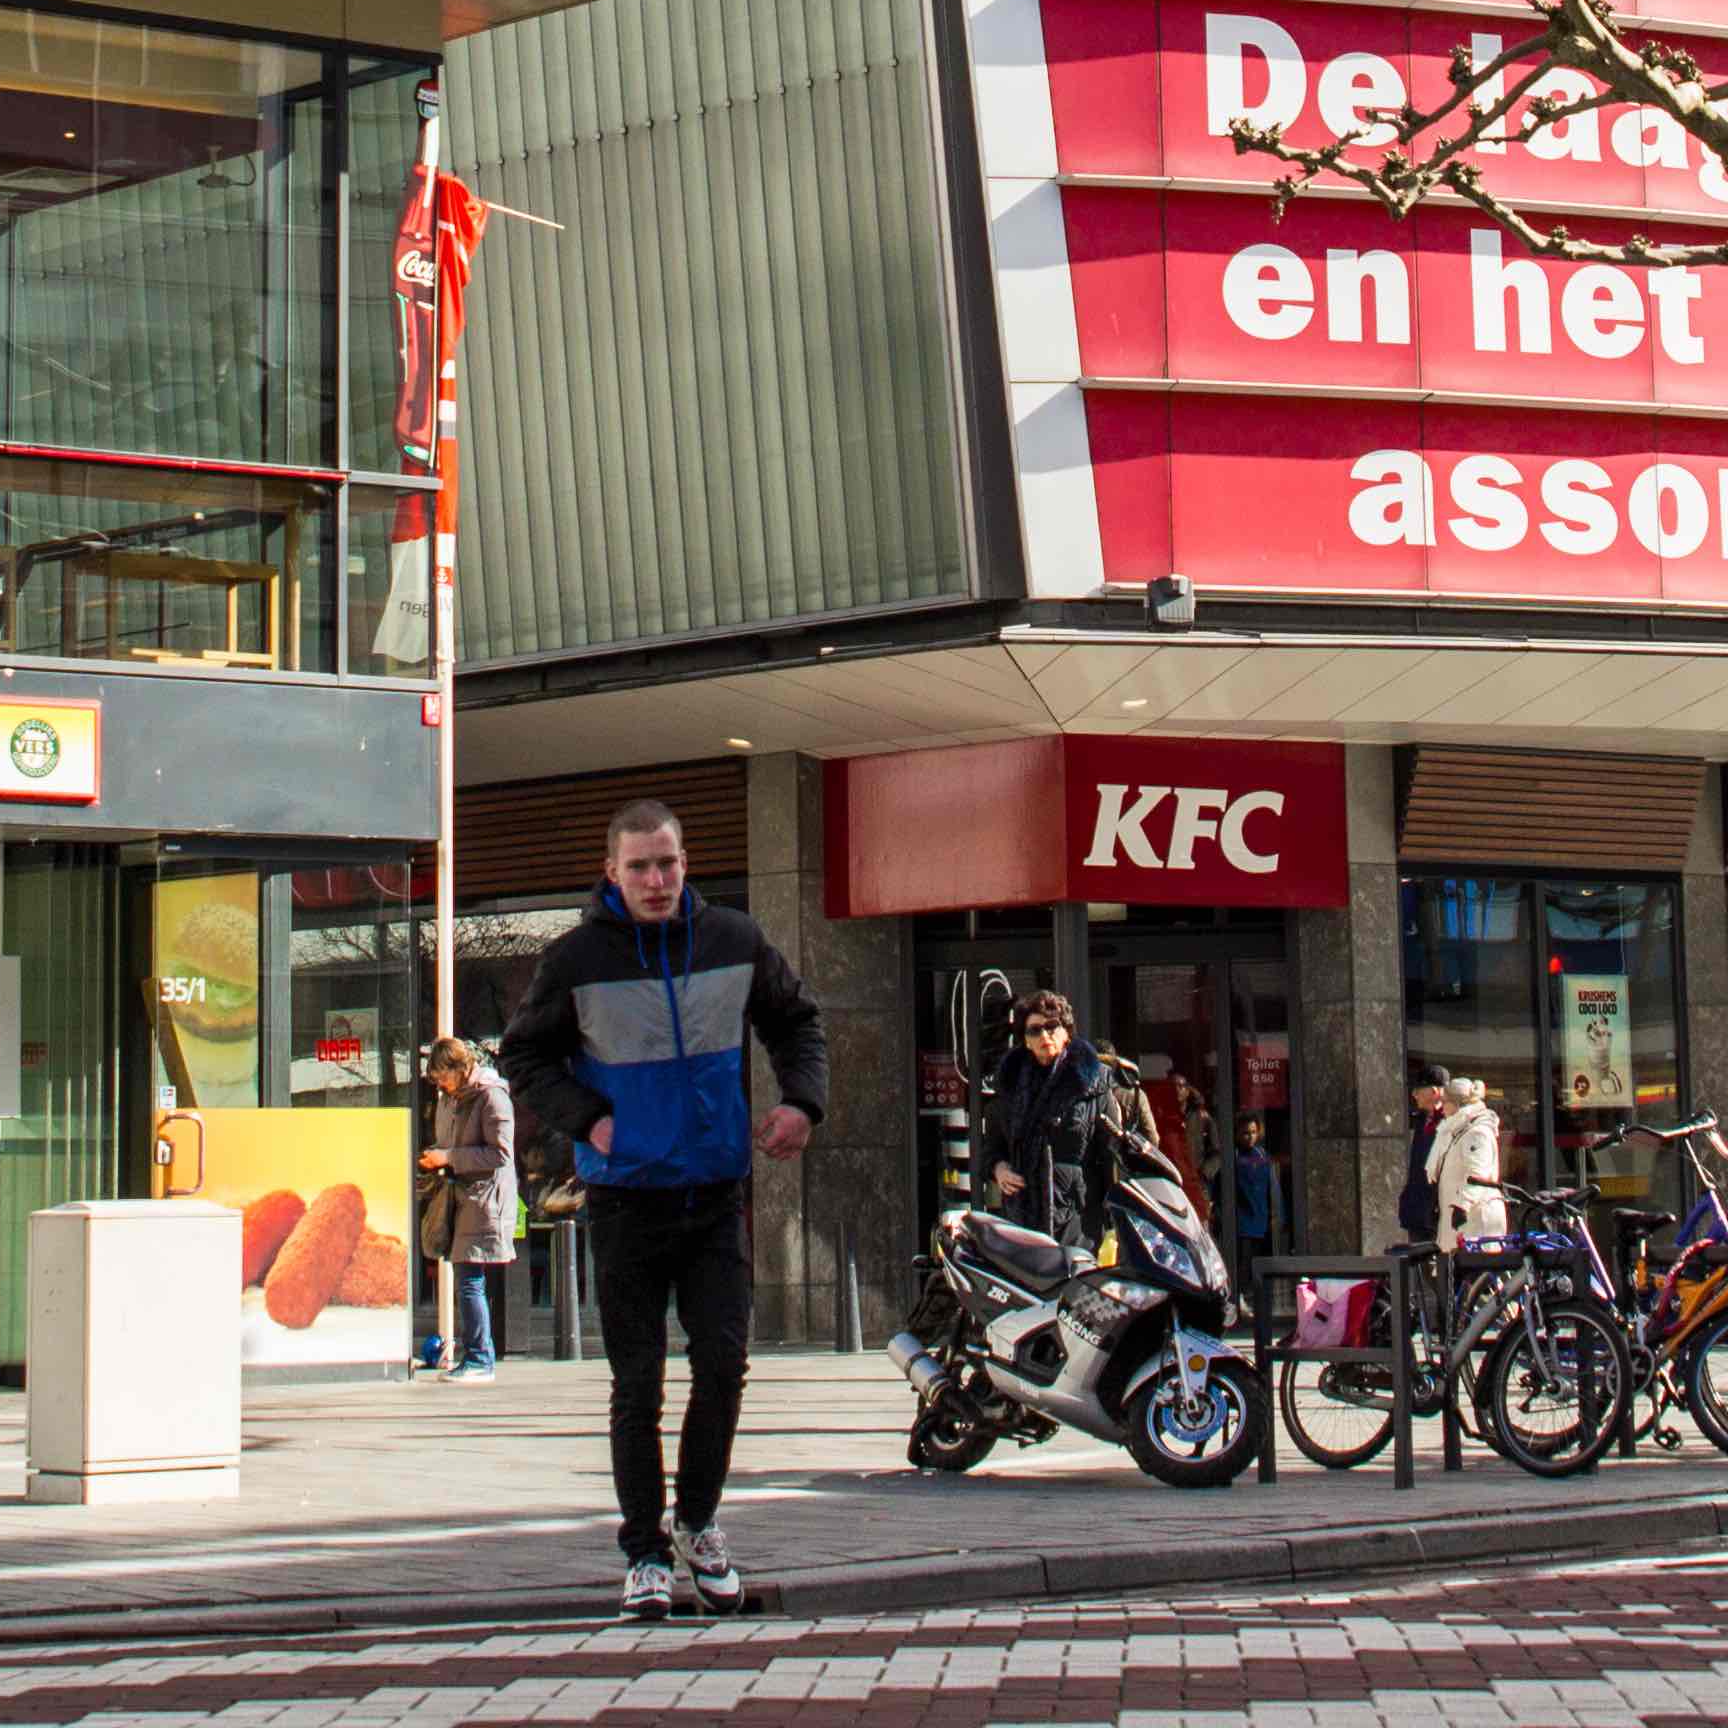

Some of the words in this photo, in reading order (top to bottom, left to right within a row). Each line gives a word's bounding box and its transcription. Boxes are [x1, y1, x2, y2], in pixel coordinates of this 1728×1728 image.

[1205, 12, 1418, 138] De
[1222, 242, 1412, 345] en
[1470, 228, 1706, 365] het
[1083, 783, 1284, 873] KFC
[161, 977, 206, 1002] 35/1
[1599, 1003, 1617, 1014] LOCO
[1057, 1309, 1103, 1346] RACING
